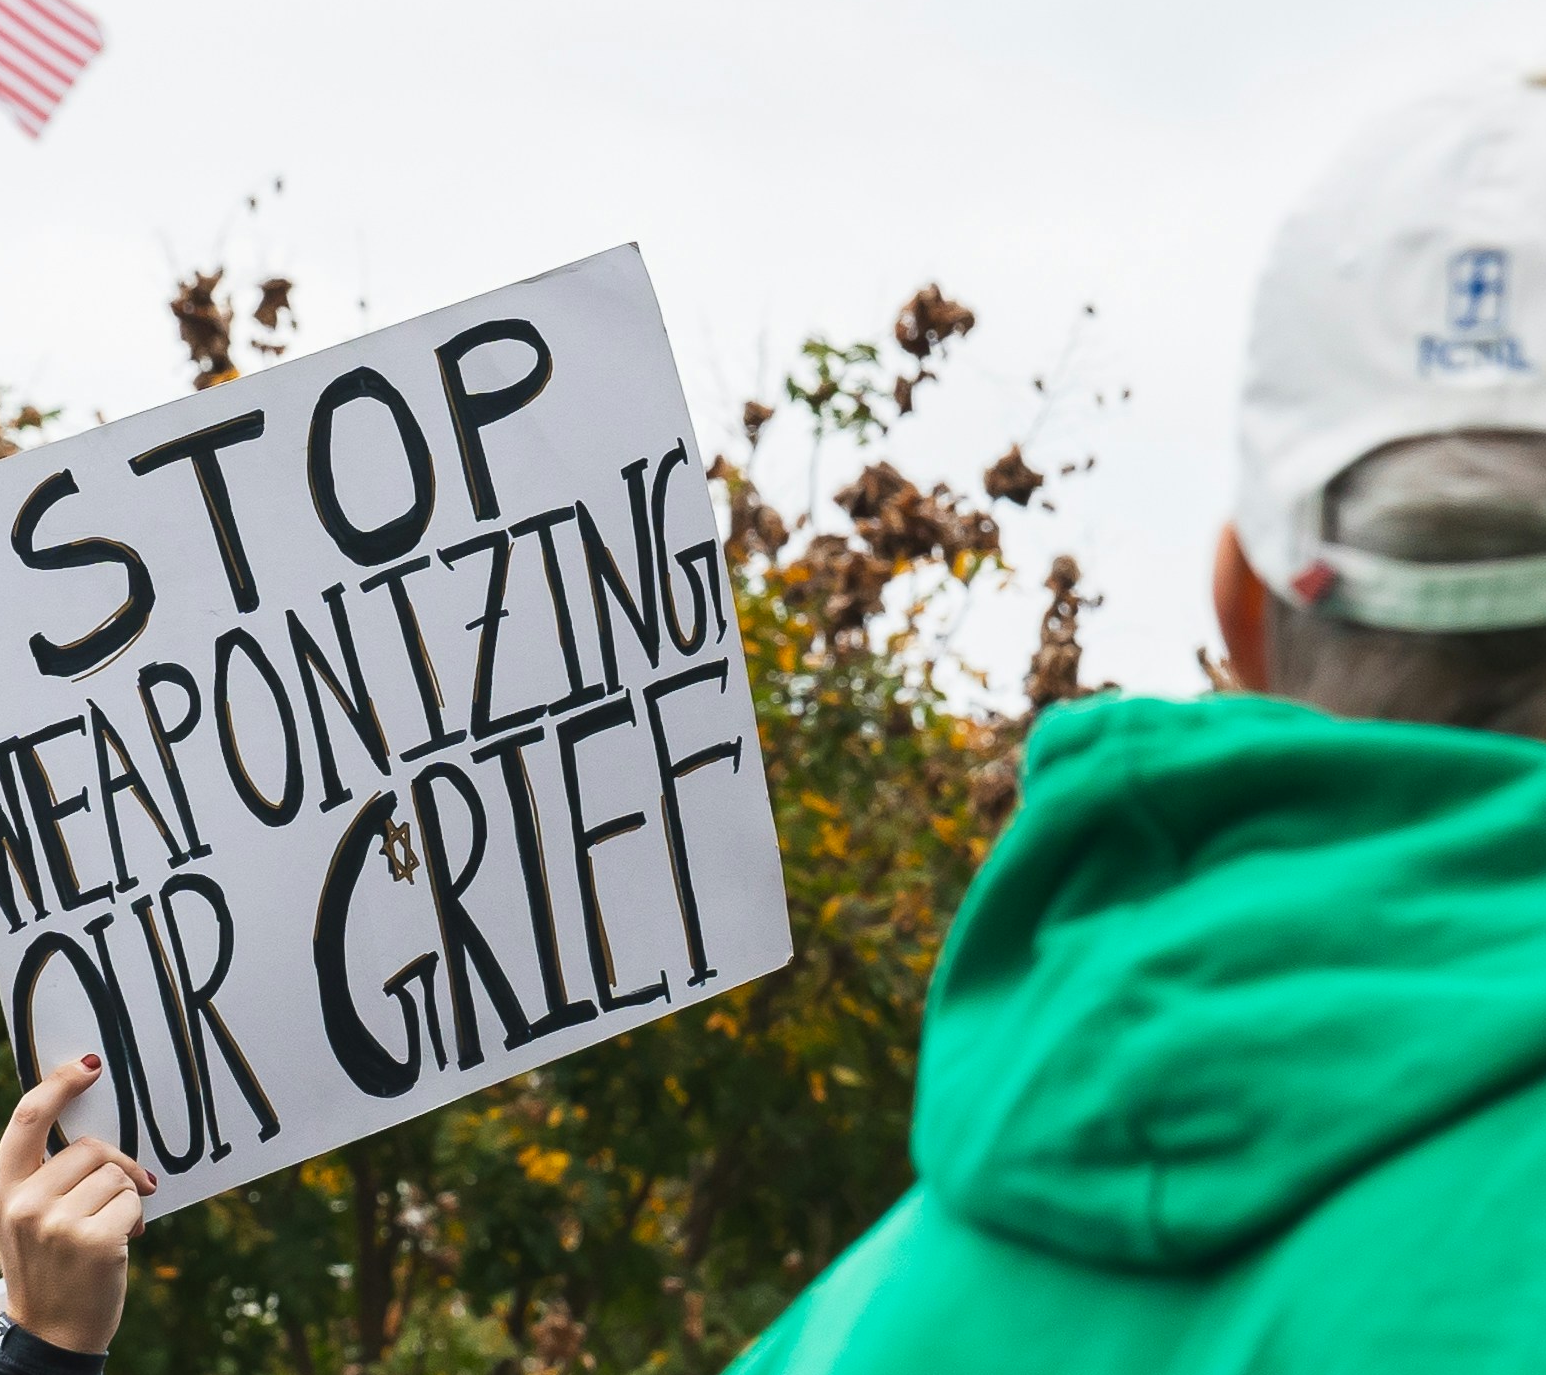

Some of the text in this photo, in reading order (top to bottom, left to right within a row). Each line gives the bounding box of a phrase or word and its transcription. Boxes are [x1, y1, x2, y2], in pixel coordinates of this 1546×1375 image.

[11, 317, 554, 683] STOP
[12, 658, 743, 1175] OUR GRIEF
